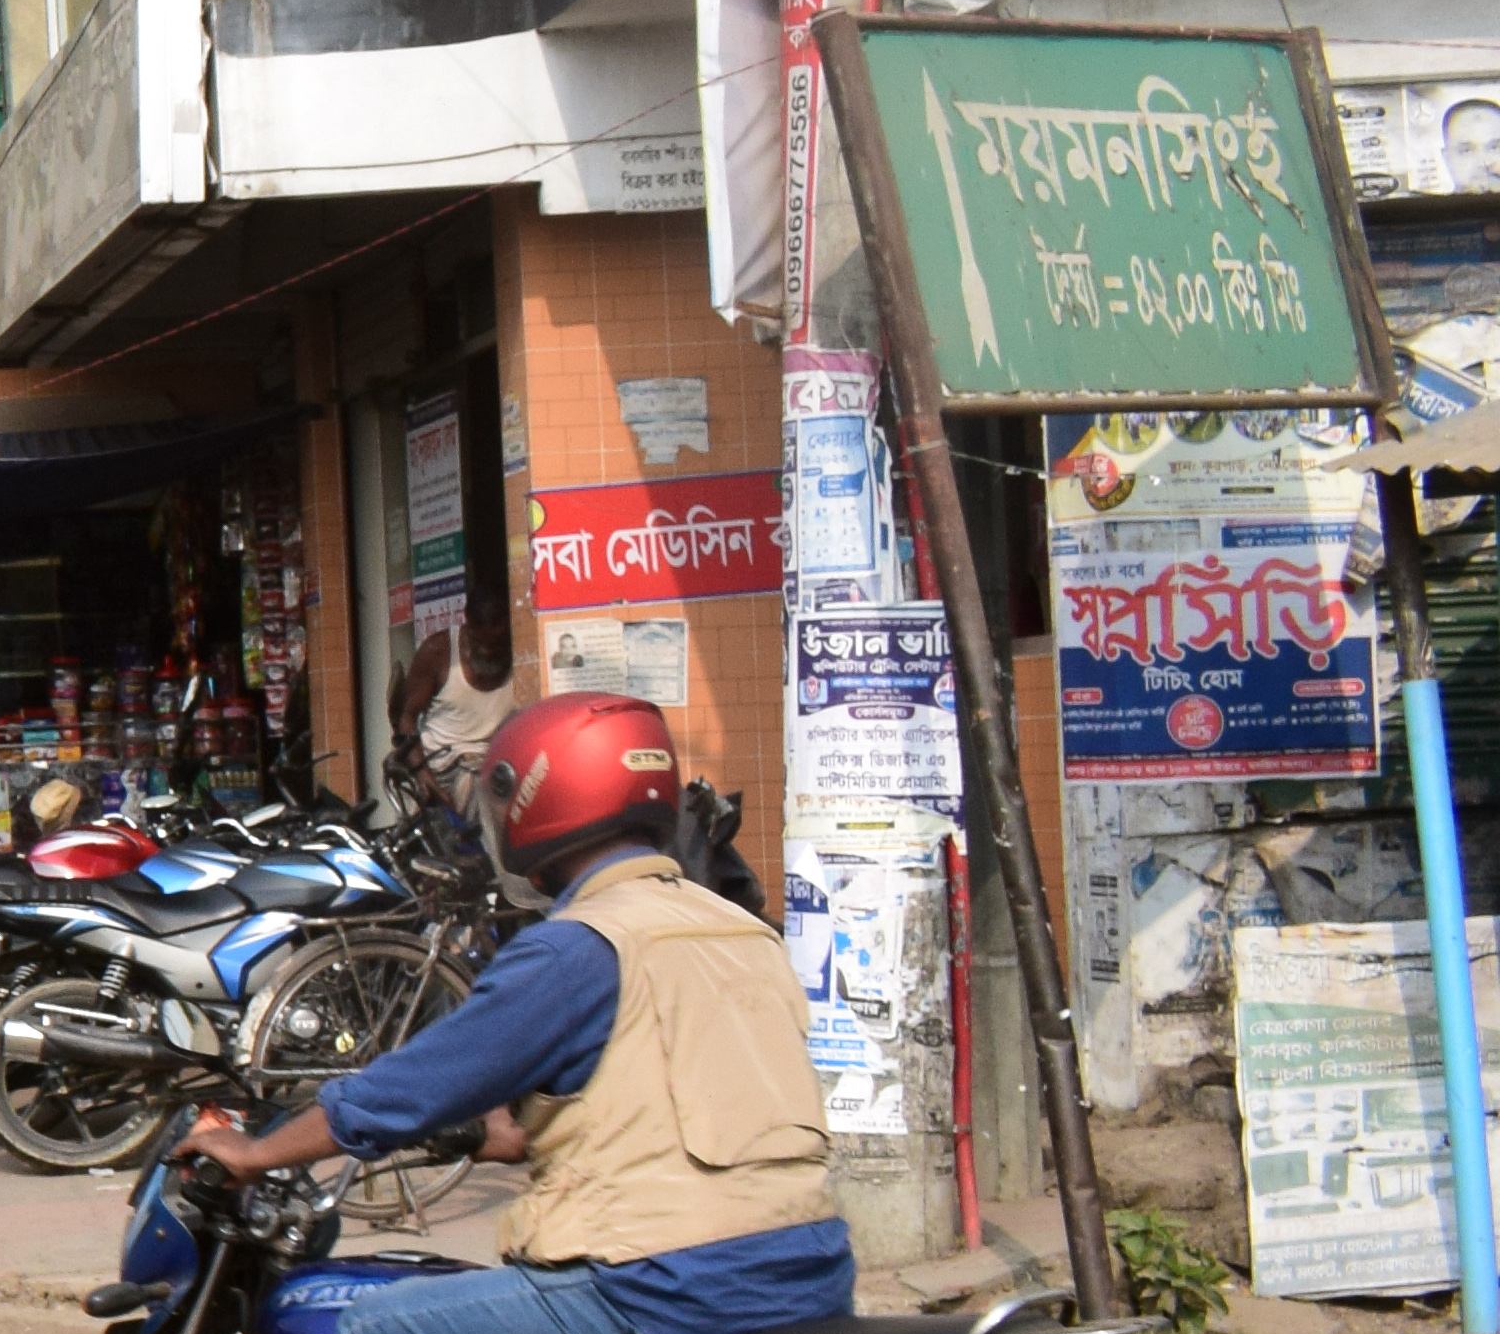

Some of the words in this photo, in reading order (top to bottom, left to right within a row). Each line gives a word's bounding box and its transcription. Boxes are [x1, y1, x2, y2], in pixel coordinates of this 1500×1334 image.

[953, 75, 1307, 229] ময়মনসিংহ
[606, 503, 755, 578] মেডিসিন
[801, 625, 890, 659] উজান
[1141, 666, 1194, 692] টিচিং
[1198, 667, 1244, 691] হোম
[862, 723, 898, 742] অফিস
[869, 748, 921, 768] ডিজাইন
